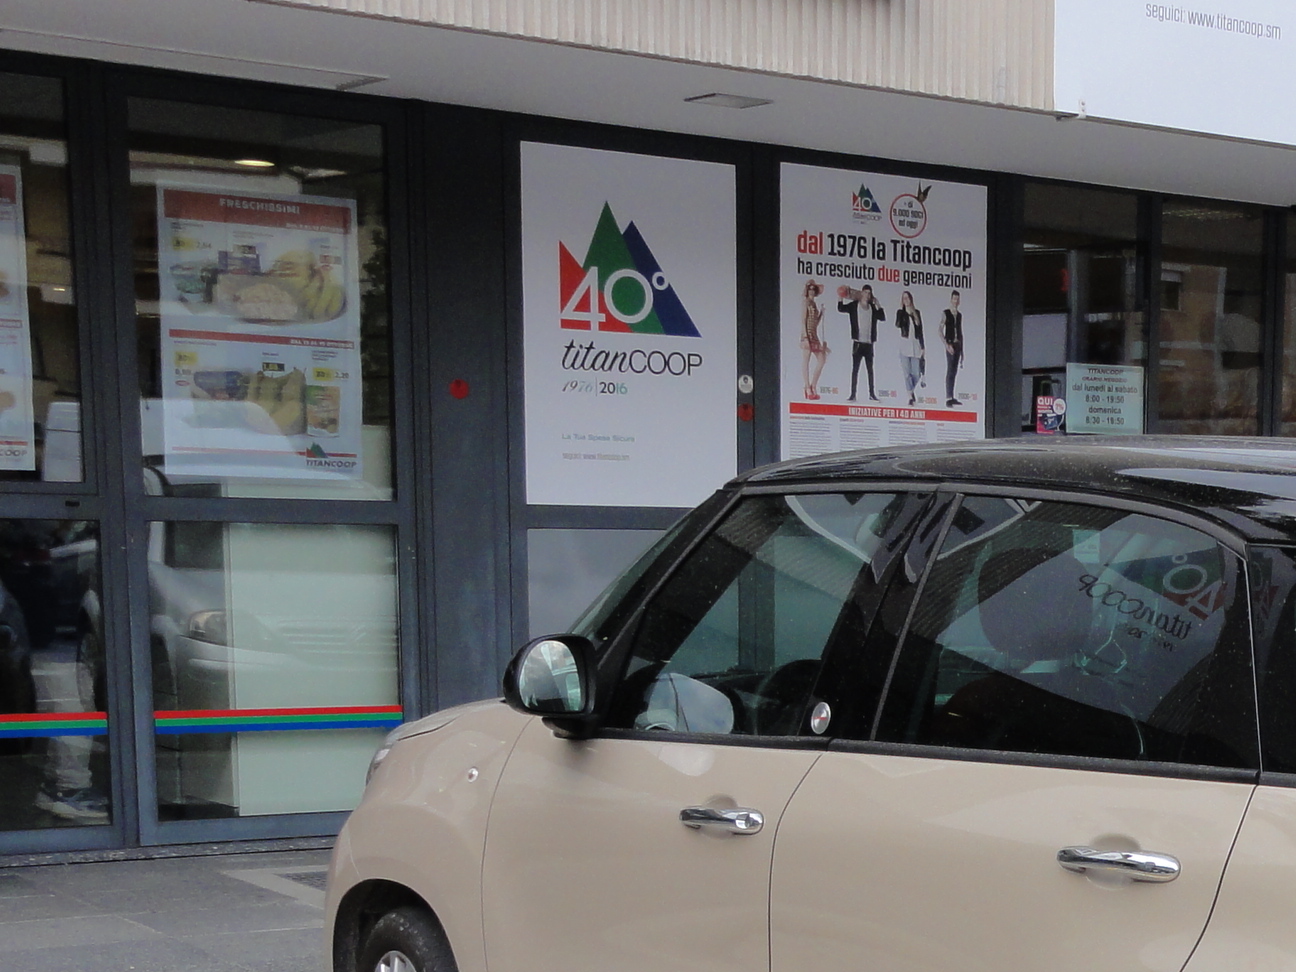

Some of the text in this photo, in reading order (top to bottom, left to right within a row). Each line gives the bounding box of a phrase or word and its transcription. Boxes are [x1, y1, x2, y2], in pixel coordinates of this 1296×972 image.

[1187, 11, 1282, 40] www.titancoop.sm
[797, 230, 972, 272] dal 1976 la Titancoop
[797, 257, 972, 289] ha cresciuto due generazioni
[561, 339, 703, 376] titanCOOP
[1072, 383, 1083, 391] dal
[1115, 385, 1138, 393] sabato
[1038, 397, 1053, 406] QUI
[848, 407, 882, 417] INIZIATIVE
[882, 410, 895, 418] PER
[899, 410, 909, 419] 40
[910, 411, 926, 419] ANNI
[1088, 406, 1122, 414] domenica
[305, 459, 358, 468] TITANCOOP
